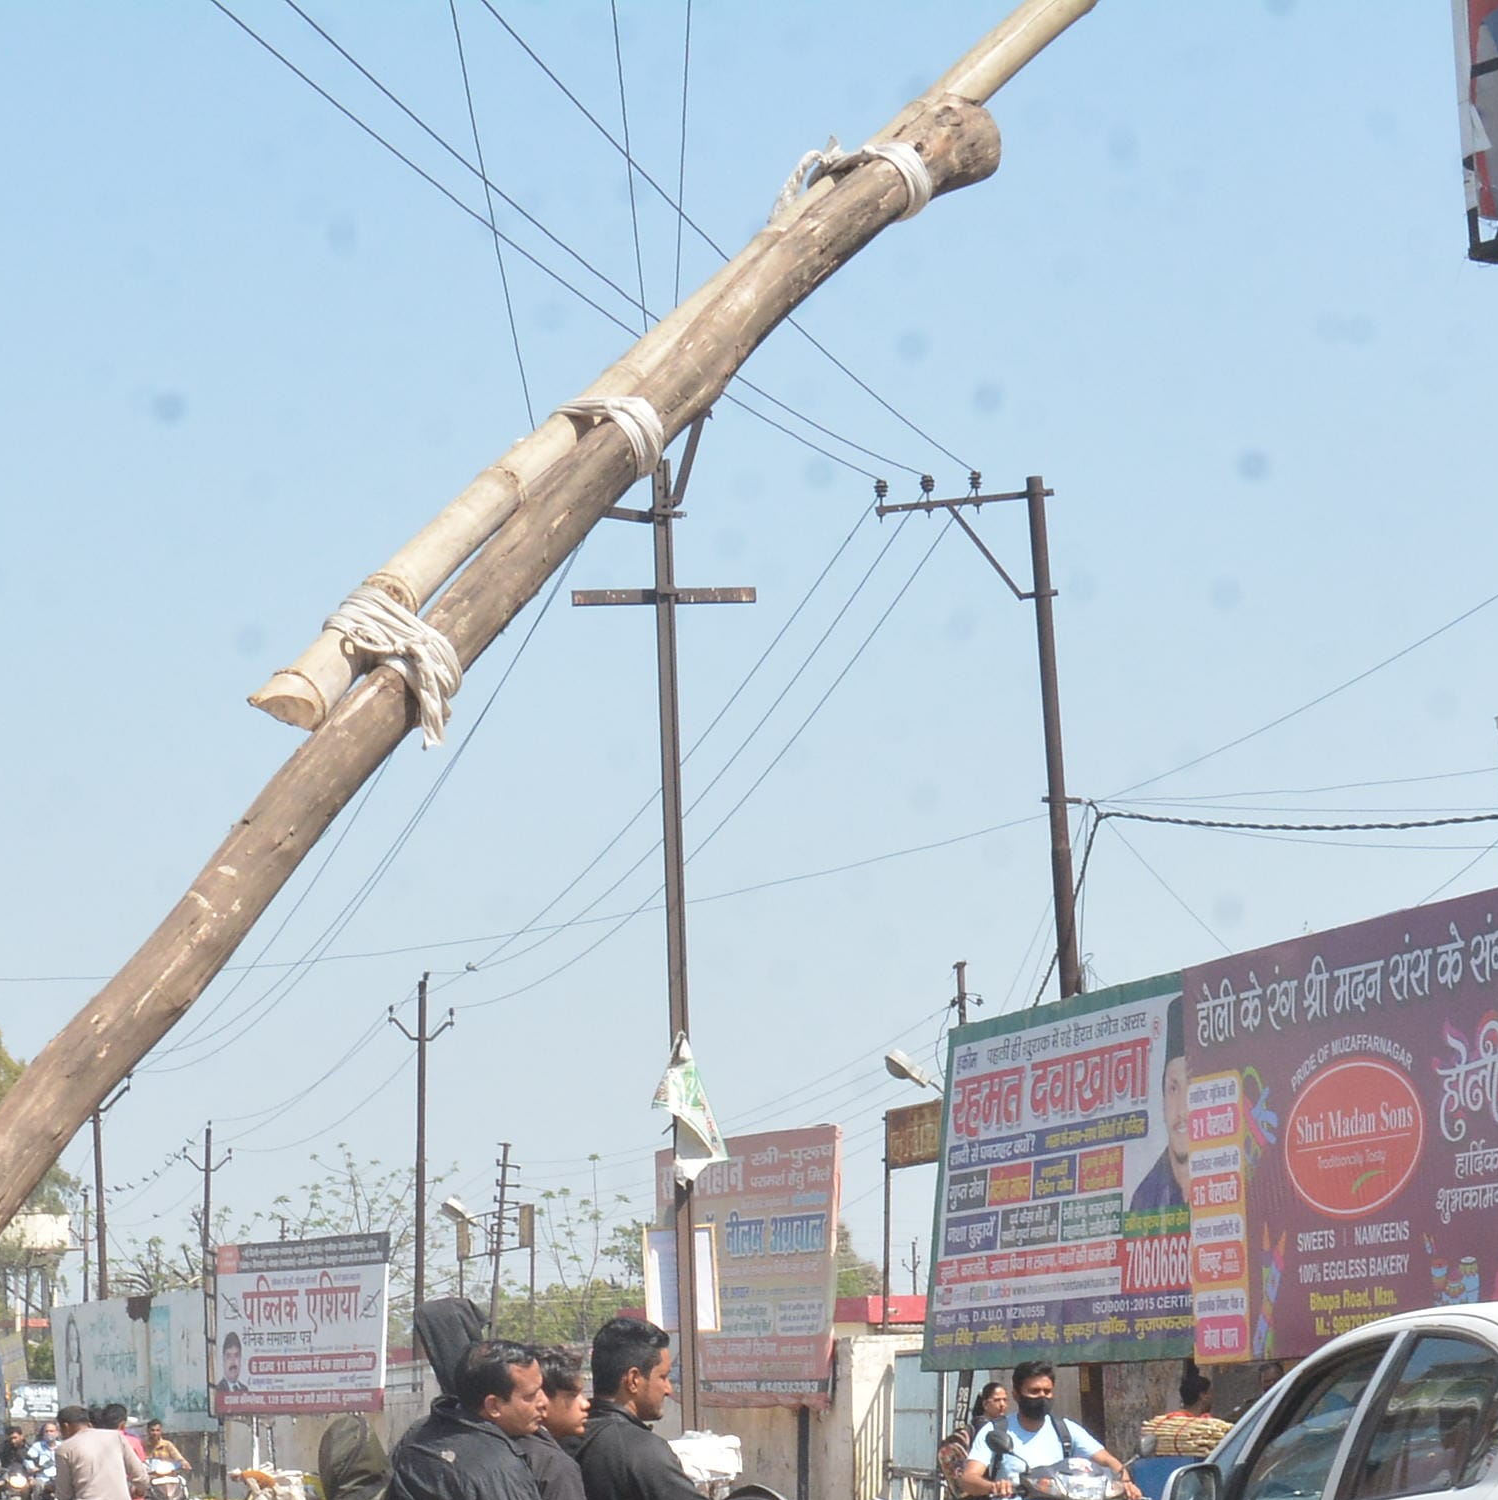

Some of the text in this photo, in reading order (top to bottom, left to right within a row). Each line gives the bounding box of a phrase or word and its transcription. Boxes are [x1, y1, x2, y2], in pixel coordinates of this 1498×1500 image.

[1196, 922, 1464, 1046] होली के रंग श्री मदन संस के
[952, 1065, 1025, 1138] रहमत
[1030, 1037, 1152, 1117] दवाखाना
[1291, 1034, 1414, 1092] PRIDE OF MUZAFFARNAGAR
[1296, 1101, 1414, 1146] Shri Madan Sons
[725, 1210, 826, 1258] नीलम अग्रवाल
[1297, 1221, 1409, 1252] SWEETS NAMKEENS
[1323, 1254, 1410, 1281] EGGLESS BAKERY
[242, 1270, 360, 1333] पब्लिक एशिया
